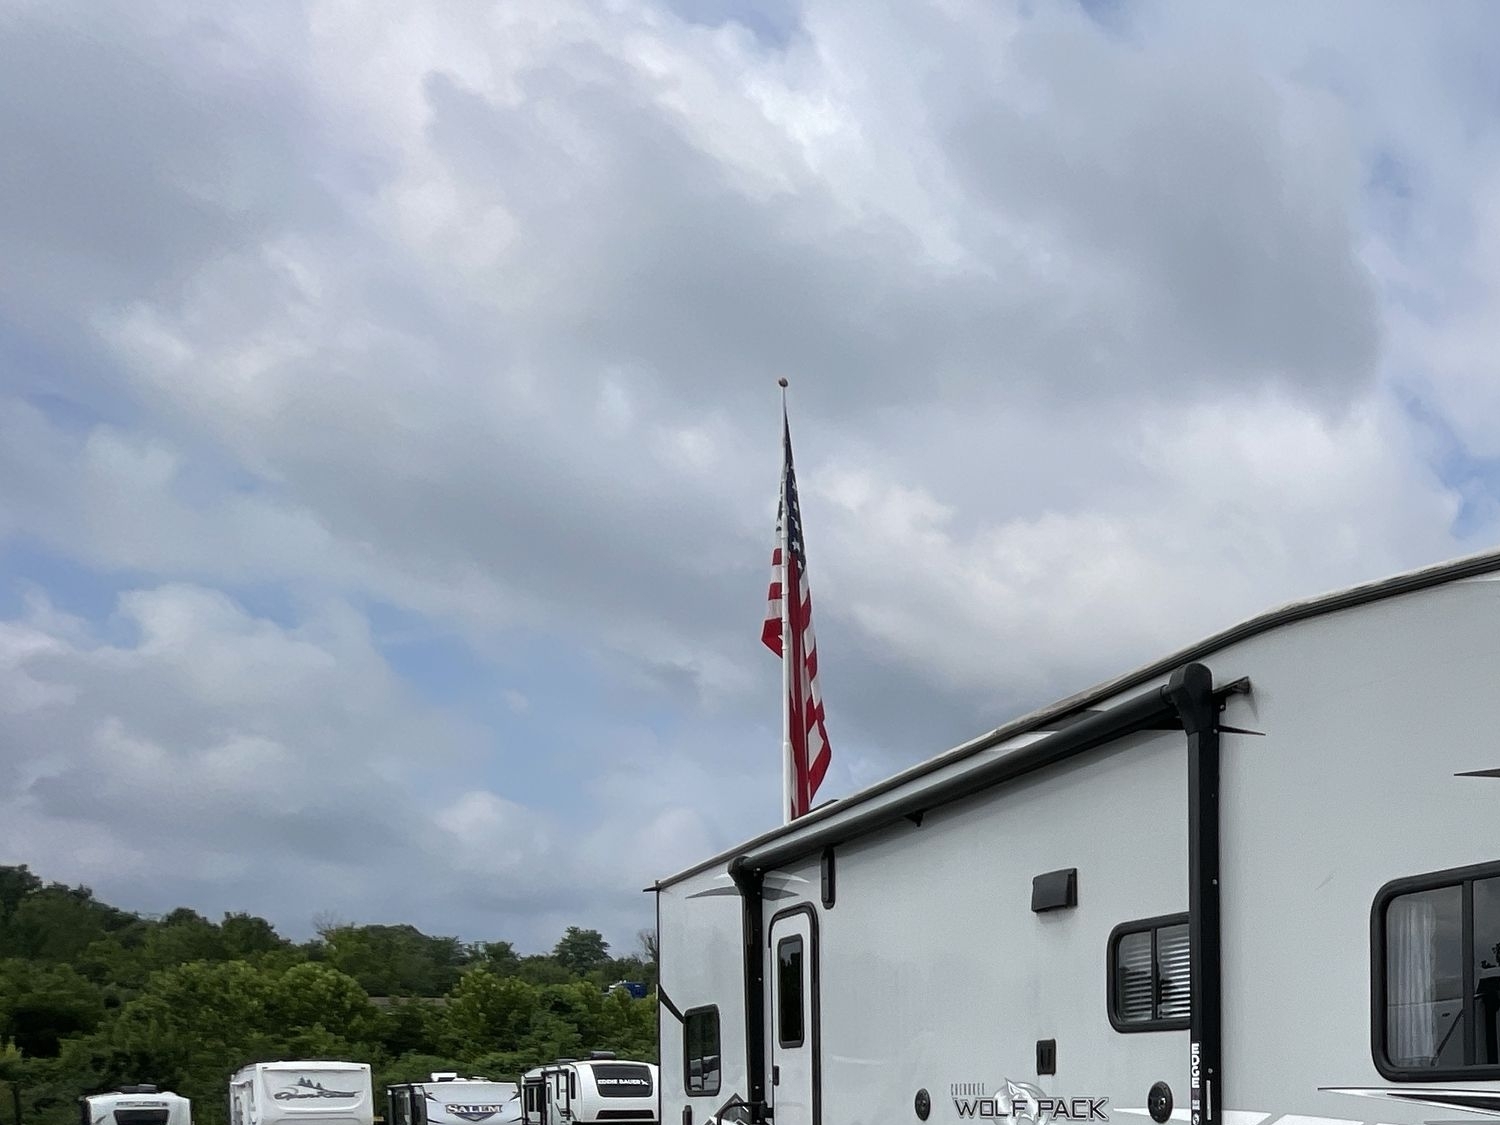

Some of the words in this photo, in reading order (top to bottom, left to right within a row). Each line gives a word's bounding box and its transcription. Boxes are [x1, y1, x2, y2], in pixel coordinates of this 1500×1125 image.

[1191, 1042, 1200, 1089] EDGE
[446, 1104, 502, 1114] SALEM
[953, 1097, 1029, 1119] WOLF
[1036, 1097, 1109, 1121] PACK
